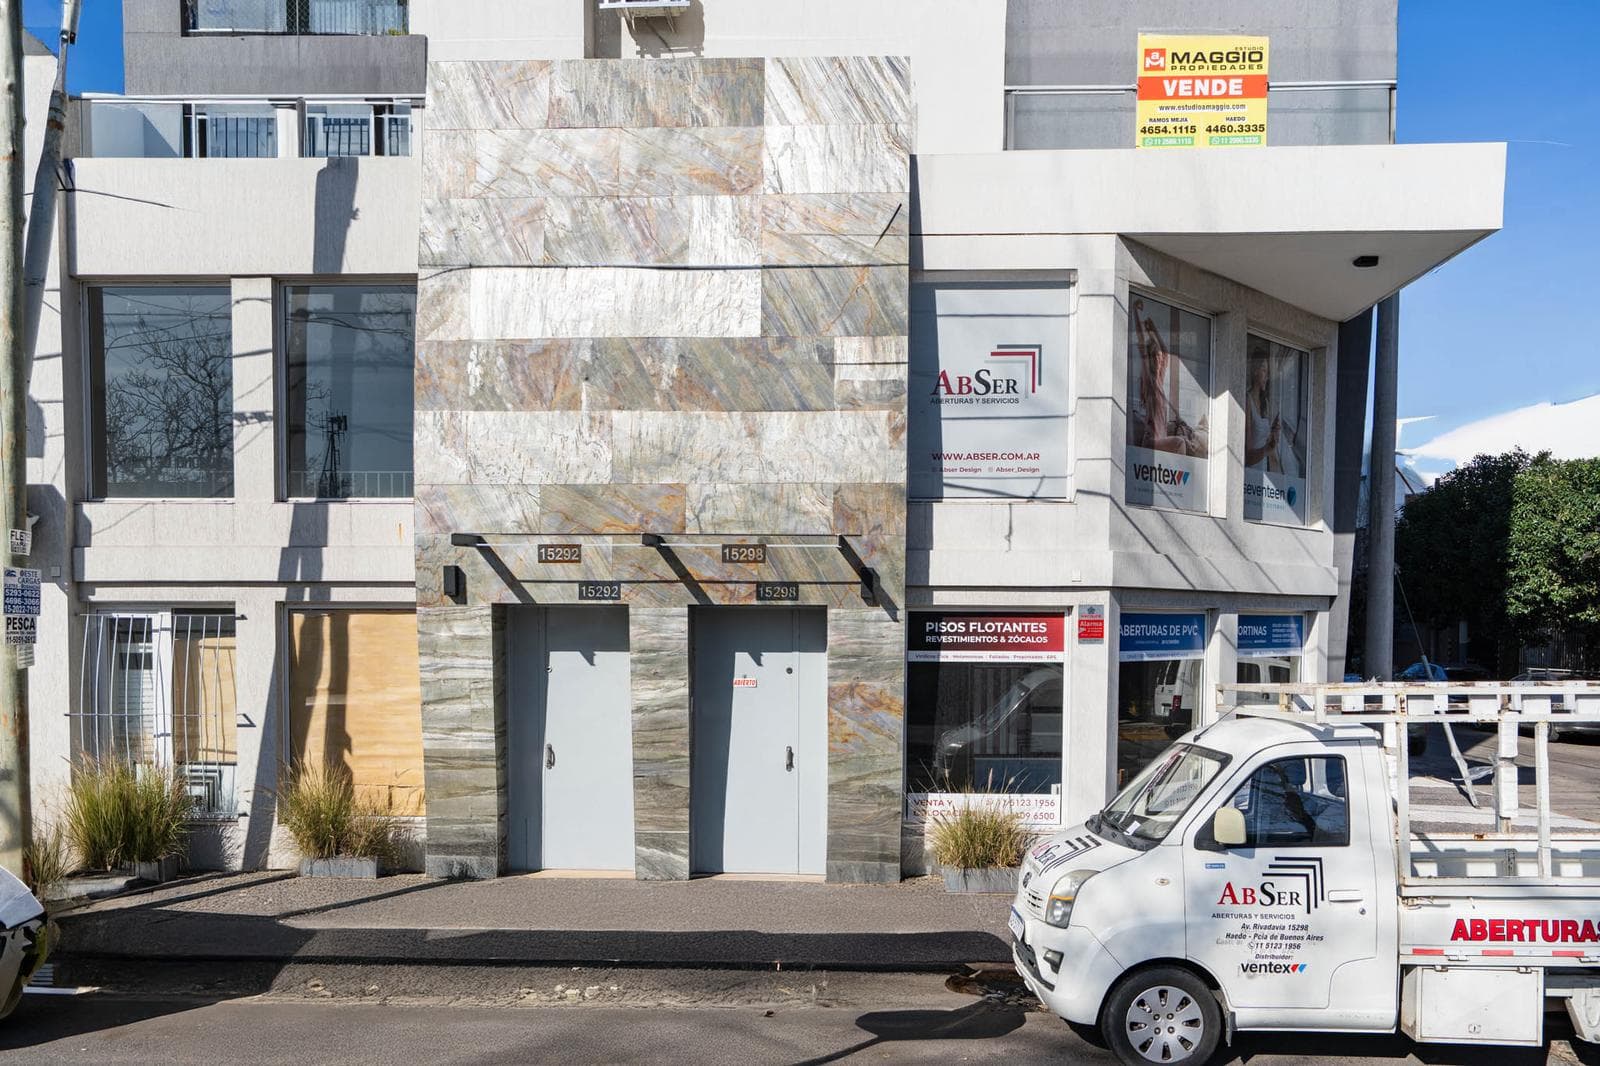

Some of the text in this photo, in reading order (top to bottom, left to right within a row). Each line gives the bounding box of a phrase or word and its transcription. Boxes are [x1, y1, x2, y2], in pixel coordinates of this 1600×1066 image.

[1171, 51, 1264, 64] MAGGIO
[1163, 78, 1243, 97] VENDE
[1158, 103, 1246, 112] www.estudioamaggio.com
[1140, 125, 1197, 135] 4654.1115
[1205, 124, 1265, 134] 4460.3335
[931, 452, 1040, 461] WWW.ABSER.COM.AR
[959, 466, 982, 474] Design
[995, 466, 1040, 474] Abser_Design
[1133, 462, 1178, 486] ventex
[539, 548, 580, 561] 15292
[723, 548, 764, 561] 15298
[17, 576, 41, 585] CARGAS
[580, 585, 619, 598] 15292
[758, 586, 797, 598] 15298
[6, 616, 36, 631] PESCA
[925, 622, 1047, 633] PISOS FLOTANTES
[1120, 624, 1199, 636] ABERTURAS DE PVC
[1237, 625, 1268, 637] ORTINAS
[925, 633, 1048, 644] REVESTIMIENTOS & ZÓCALOS
[914, 799, 953, 807] VENTA Y
[1034, 799, 1056, 807] 1956
[1033, 812, 1055, 820] 6500
[1252, 923, 1286, 931] Rivadavia
[1450, 919, 1600, 943] ABERTURA
[1280, 933, 1304, 941] Buenos
[1285, 942, 1301, 950] 1956
[1241, 962, 1291, 973] ventex
